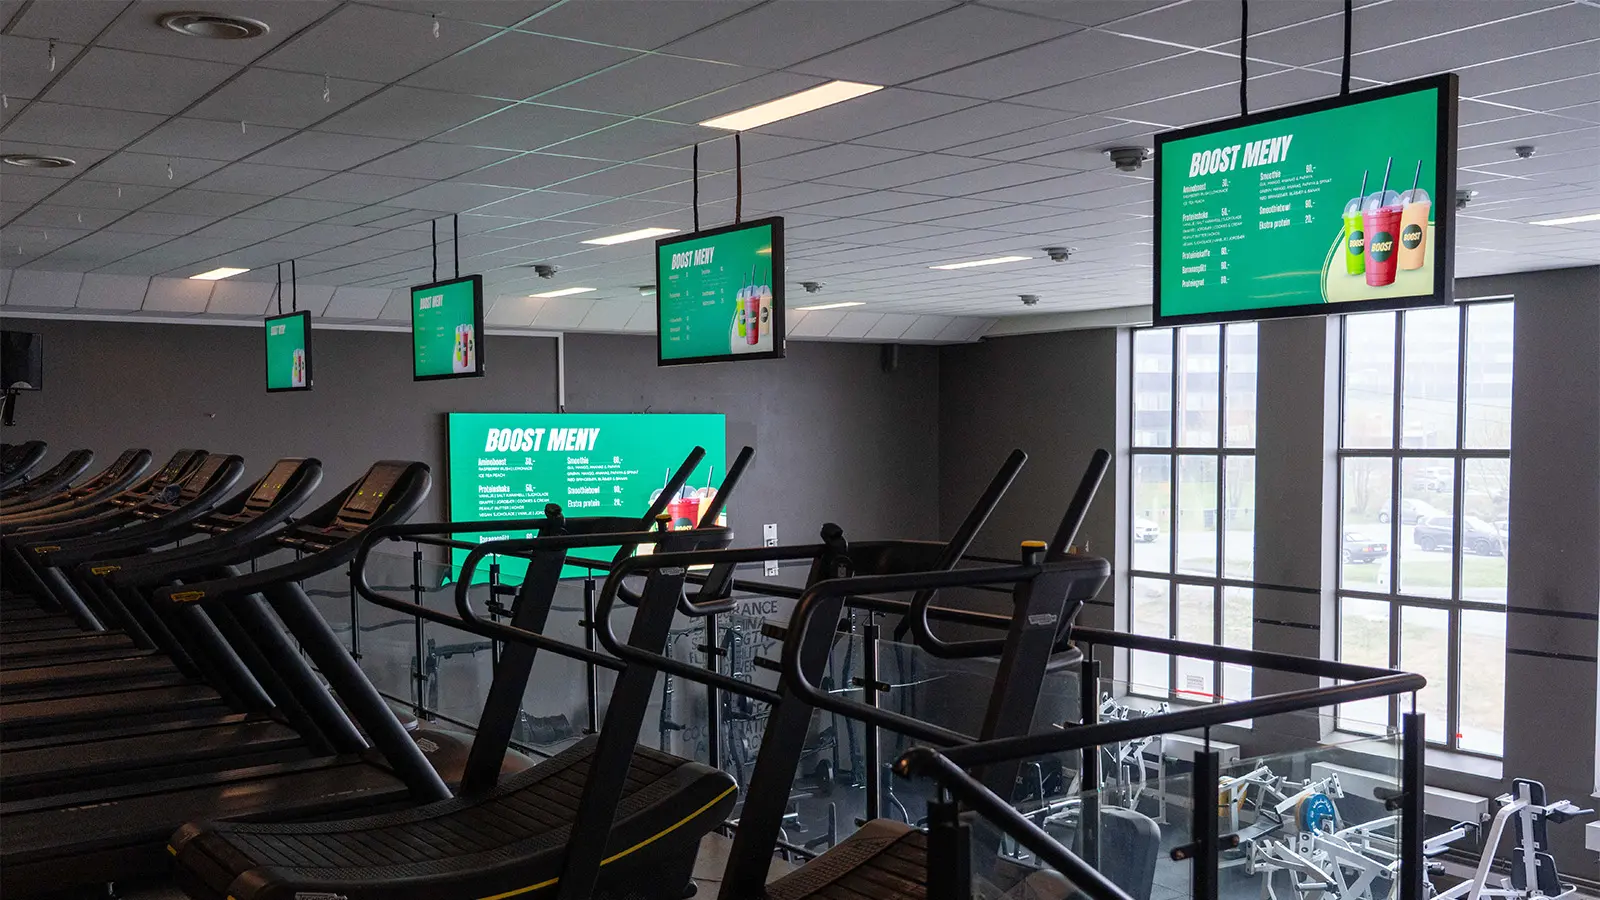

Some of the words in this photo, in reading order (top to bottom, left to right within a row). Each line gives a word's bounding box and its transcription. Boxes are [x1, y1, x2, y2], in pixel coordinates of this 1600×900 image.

[1189, 145, 1241, 178] BOOST
[1242, 134, 1293, 168] MENY
[1260, 170, 1281, 180] Smoothie
[1183, 183, 1206, 193] Aminoboost
[1259, 203, 1291, 214] Smoothiebowl
[1259, 221, 1273, 230] Ekstra
[1274, 218, 1290, 229] protein
[1404, 232, 1421, 241] BOOST
[1371, 241, 1393, 252] BOOST
[672, 251, 692, 269] BOOST
[694, 247, 715, 265] MENY
[485, 428, 546, 452] BOOST
[547, 428, 600, 451] MENY
[478, 458, 506, 466] Aminoboost
[478, 485, 510, 493] Proteinshake
[568, 486, 600, 494] Smoothiebowl
[583, 499, 600, 508] protein
